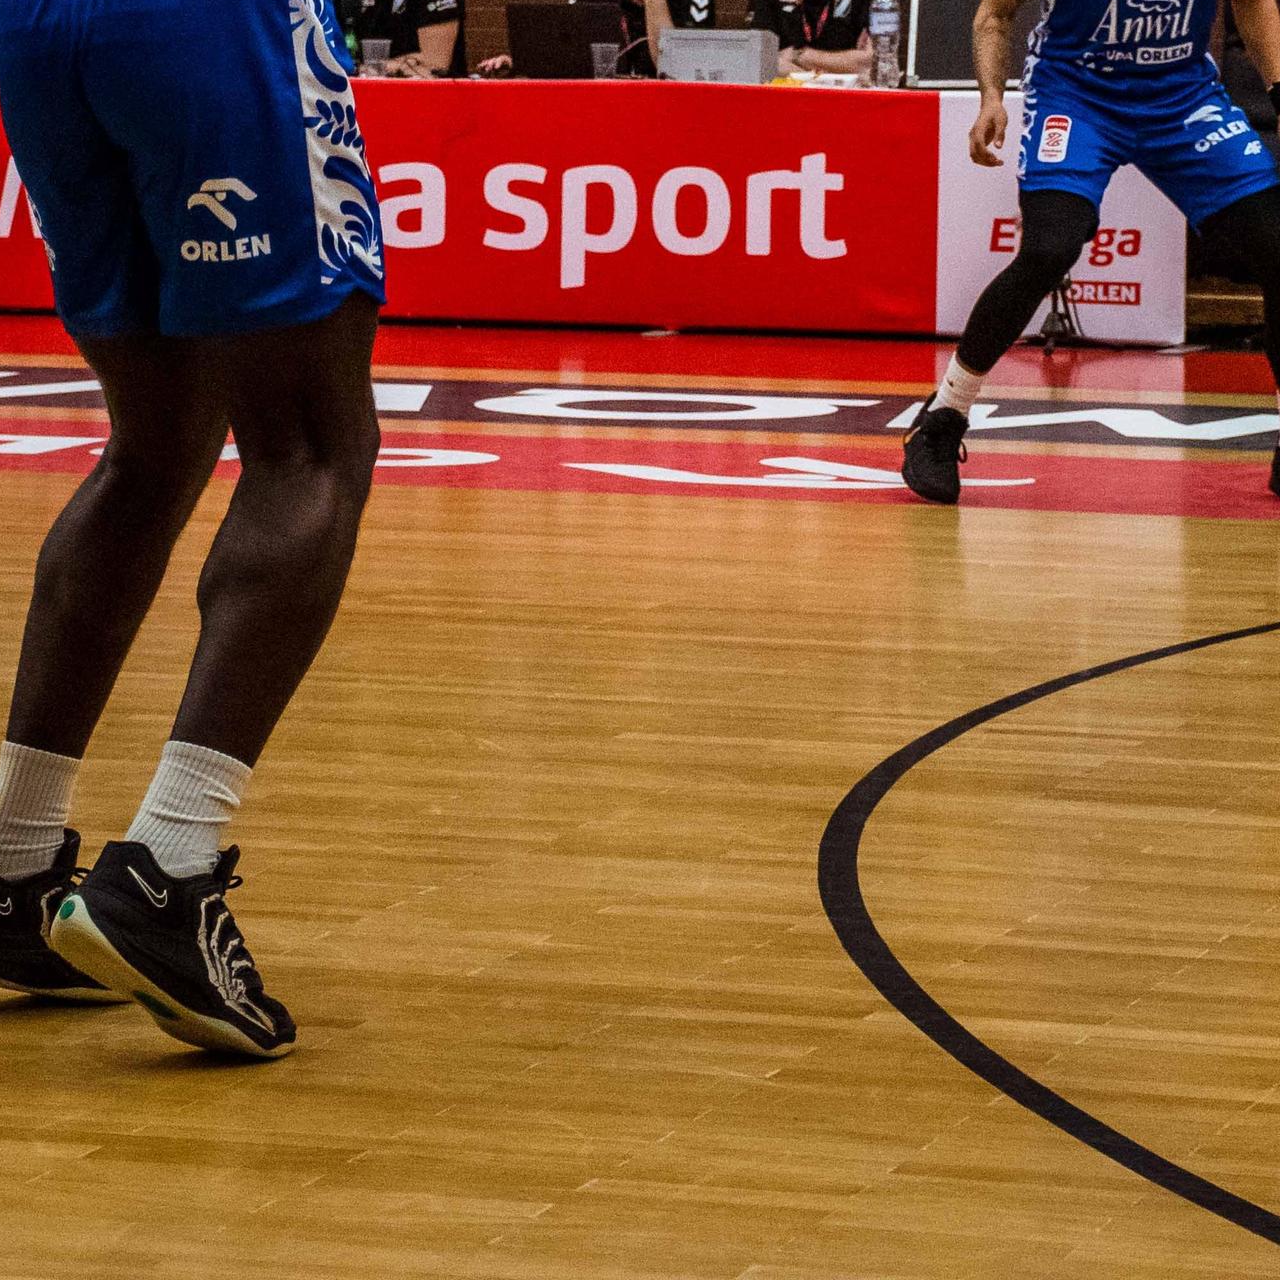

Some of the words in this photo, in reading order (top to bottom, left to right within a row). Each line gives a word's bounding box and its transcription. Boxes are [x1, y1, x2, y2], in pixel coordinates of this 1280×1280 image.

[1140, 45, 1190, 62] ORLEN
[483, 152, 848, 289] sport
[180, 232, 272, 263] ORLEN
[989, 217, 1142, 268] Ega
[1068, 284, 1138, 304] ORLEN
